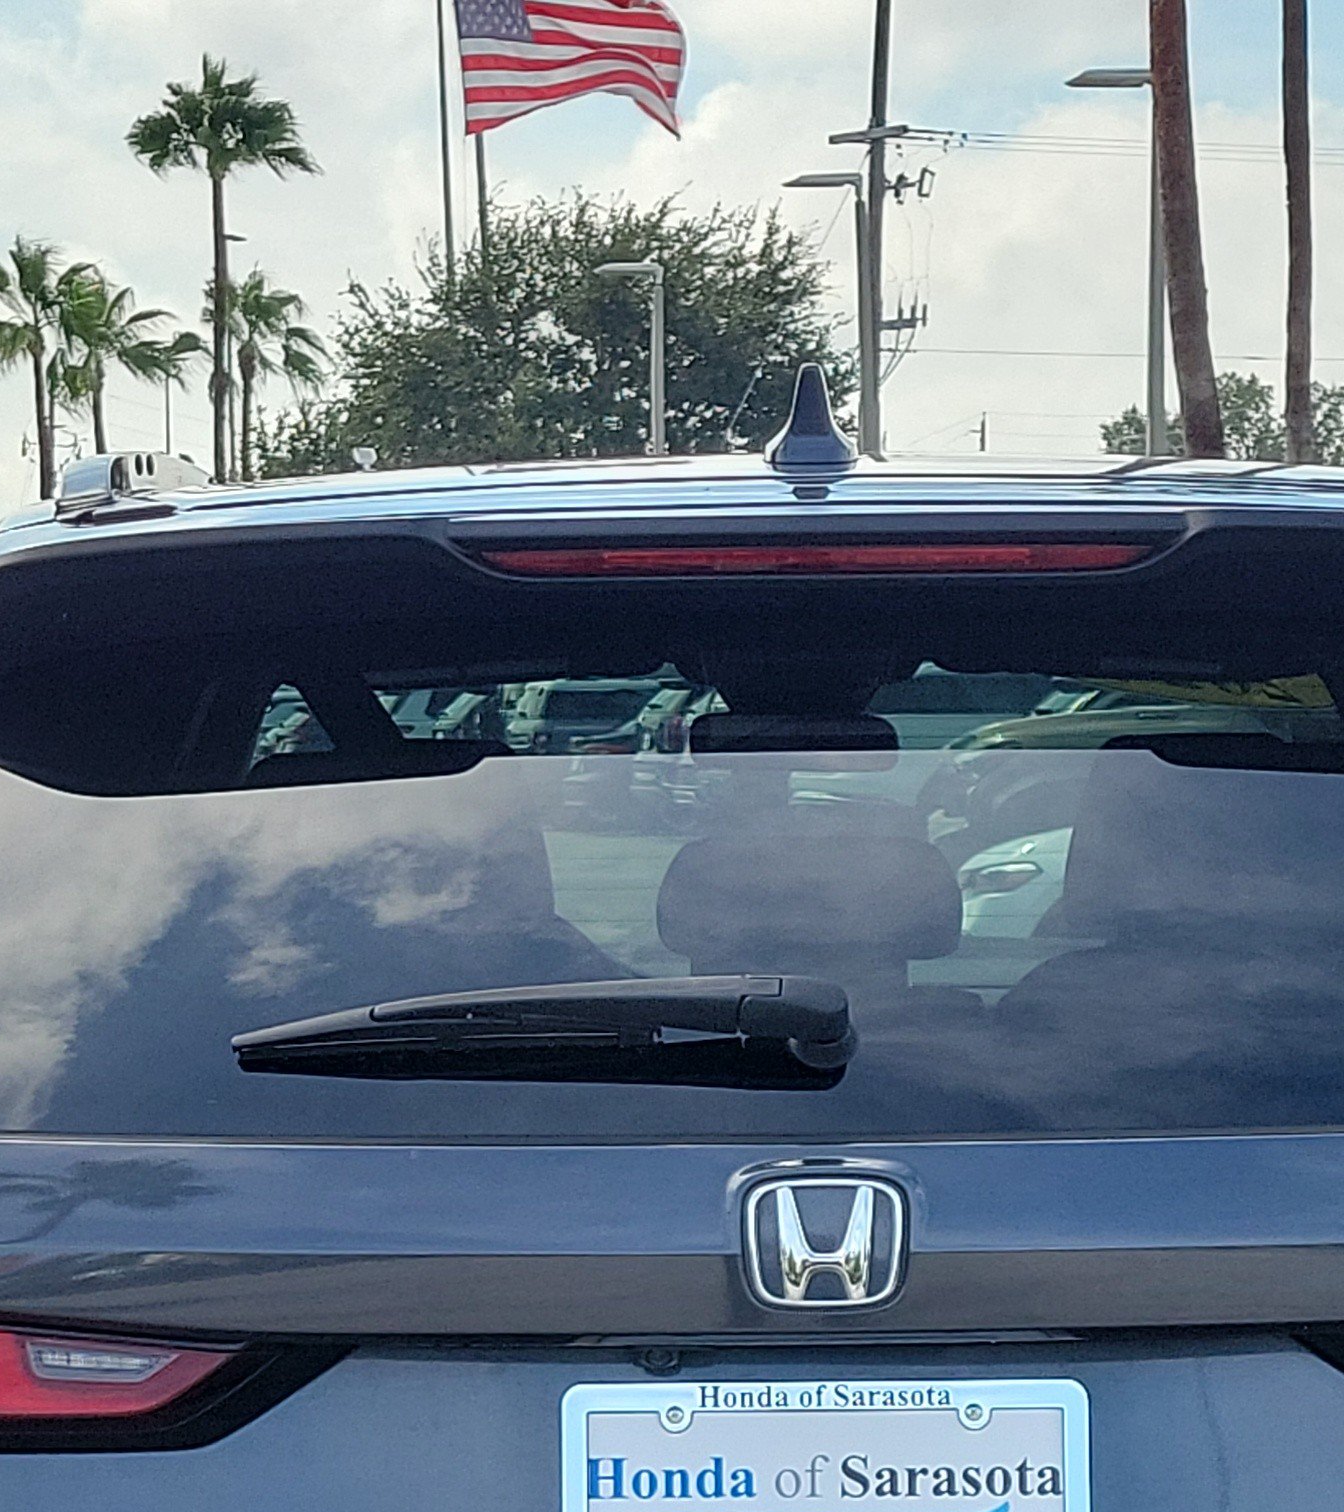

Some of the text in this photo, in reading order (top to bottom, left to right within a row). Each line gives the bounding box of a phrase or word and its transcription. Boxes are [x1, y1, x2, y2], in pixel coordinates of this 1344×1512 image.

[698, 1385, 951, 1408] Honda of Sarasota
[588, 1454, 1063, 1500] Honda of Sarasota
